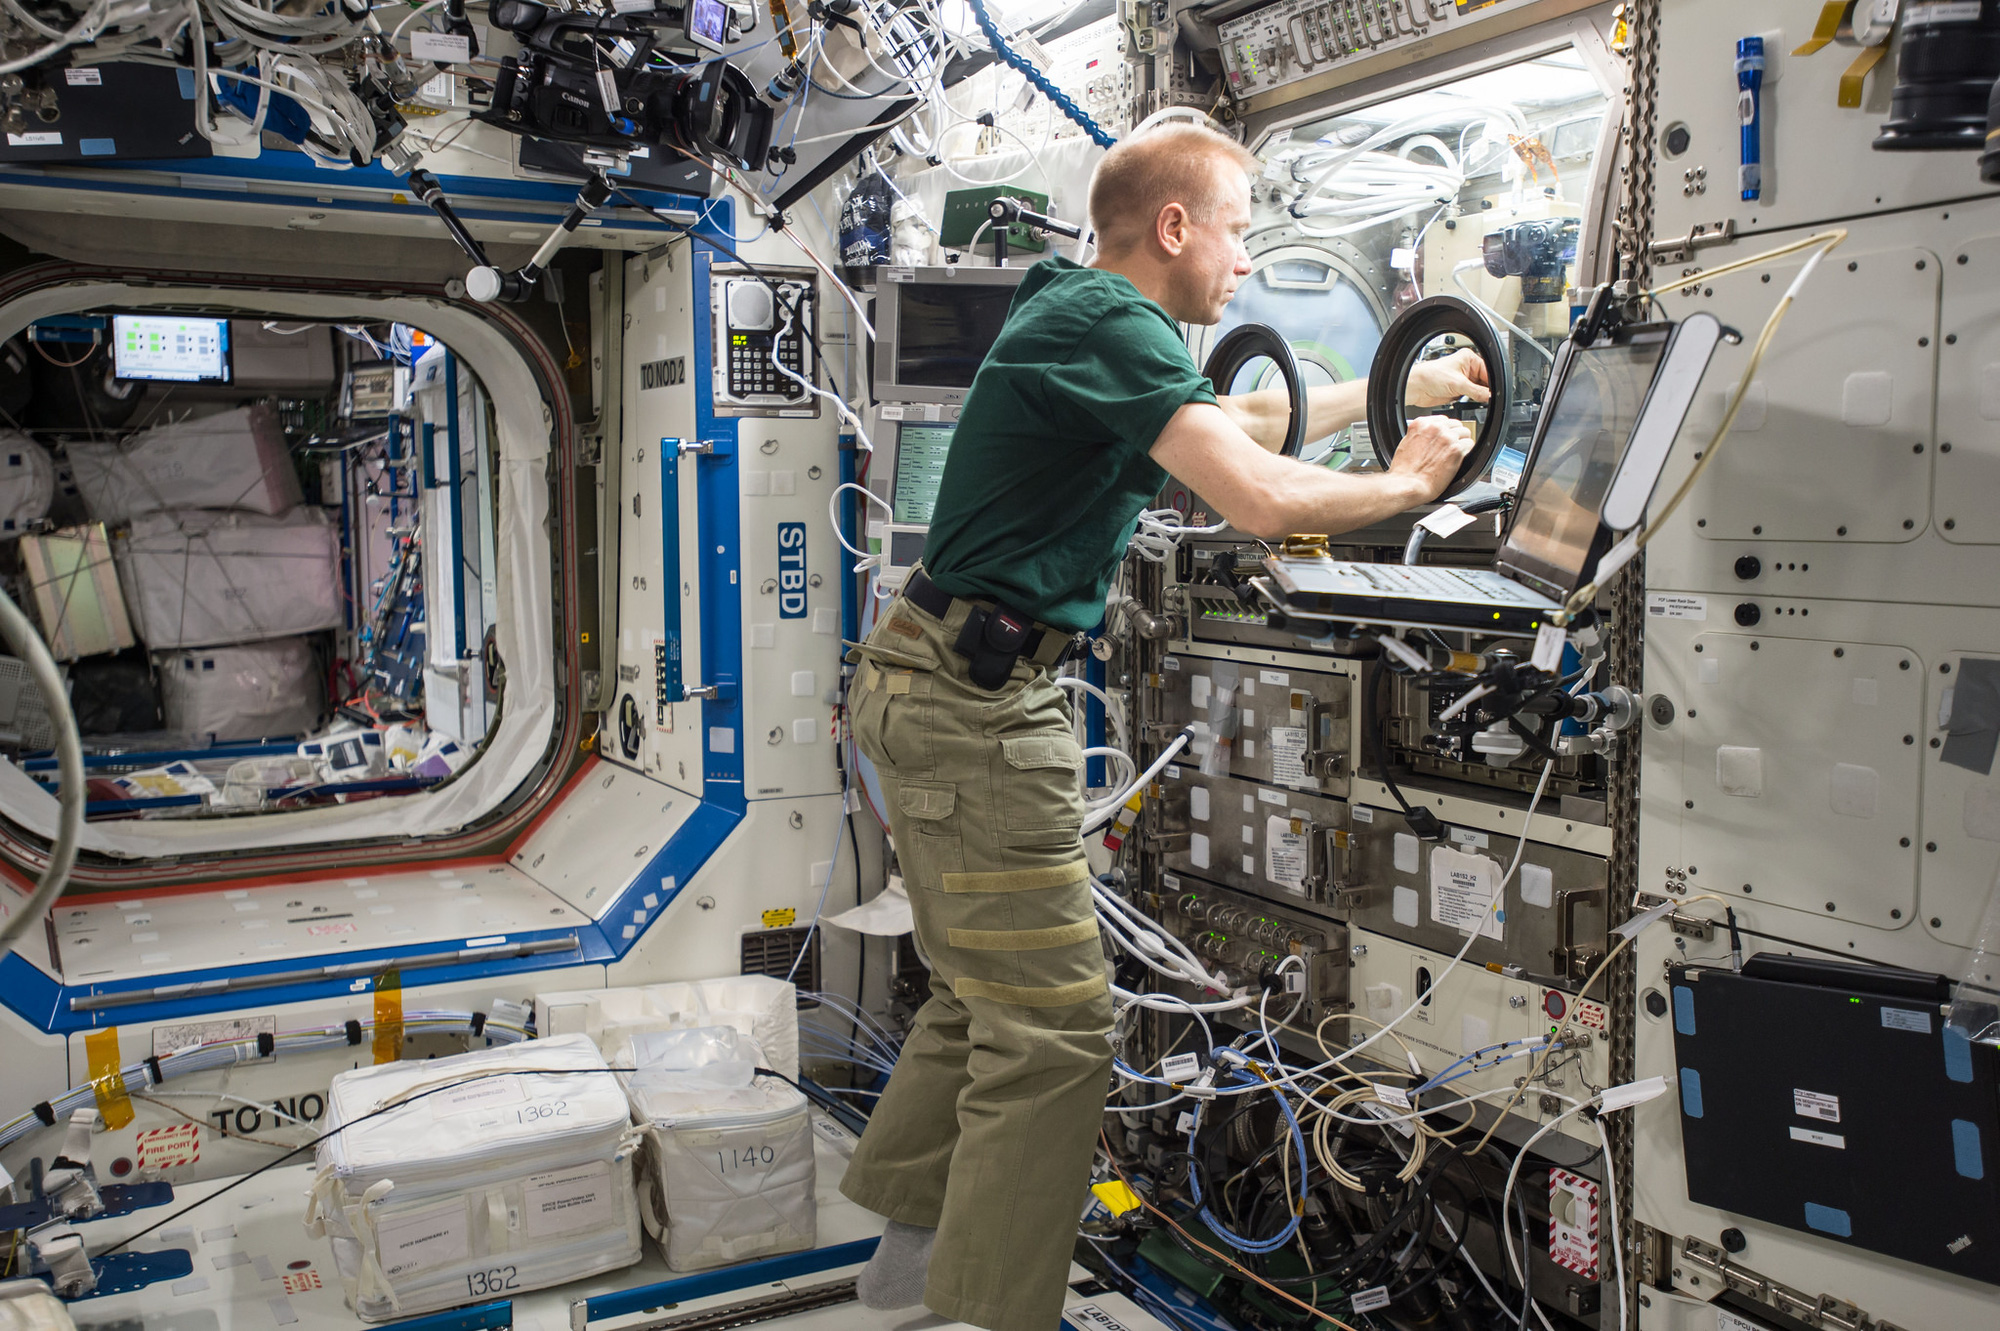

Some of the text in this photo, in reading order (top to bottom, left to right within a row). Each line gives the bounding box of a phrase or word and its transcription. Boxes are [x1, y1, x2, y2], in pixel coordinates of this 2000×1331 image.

[561, 92, 590, 109] Canon
[640, 359, 686, 389] TO NOD 2
[780, 528, 805, 614] STBD
[1417, 1014, 1429, 1022] POWER
[1403, 1033, 1416, 1042] POWER
[1415, 1038, 1439, 1051] DISTRIBUTION
[1440, 1045, 1457, 1058] ASSEMBLY
[212, 1091, 329, 1138] TO NO
[517, 1101, 570, 1124] 1362
[144, 1133, 179, 1144] EMERGENCY
[146, 1141, 191, 1155] FIRE PORT
[718, 1146, 774, 1173] 1140
[414, 1232, 443, 1246] HARDWARE
[1947, 1234, 1972, 1254] ThinkPad
[1557, 1247, 1570, 1259] RACK
[1572, 1254, 1589, 1268] POWER
[466, 1265, 521, 1296] 1362
[1084, 1307, 1126, 1331] LAB1D
